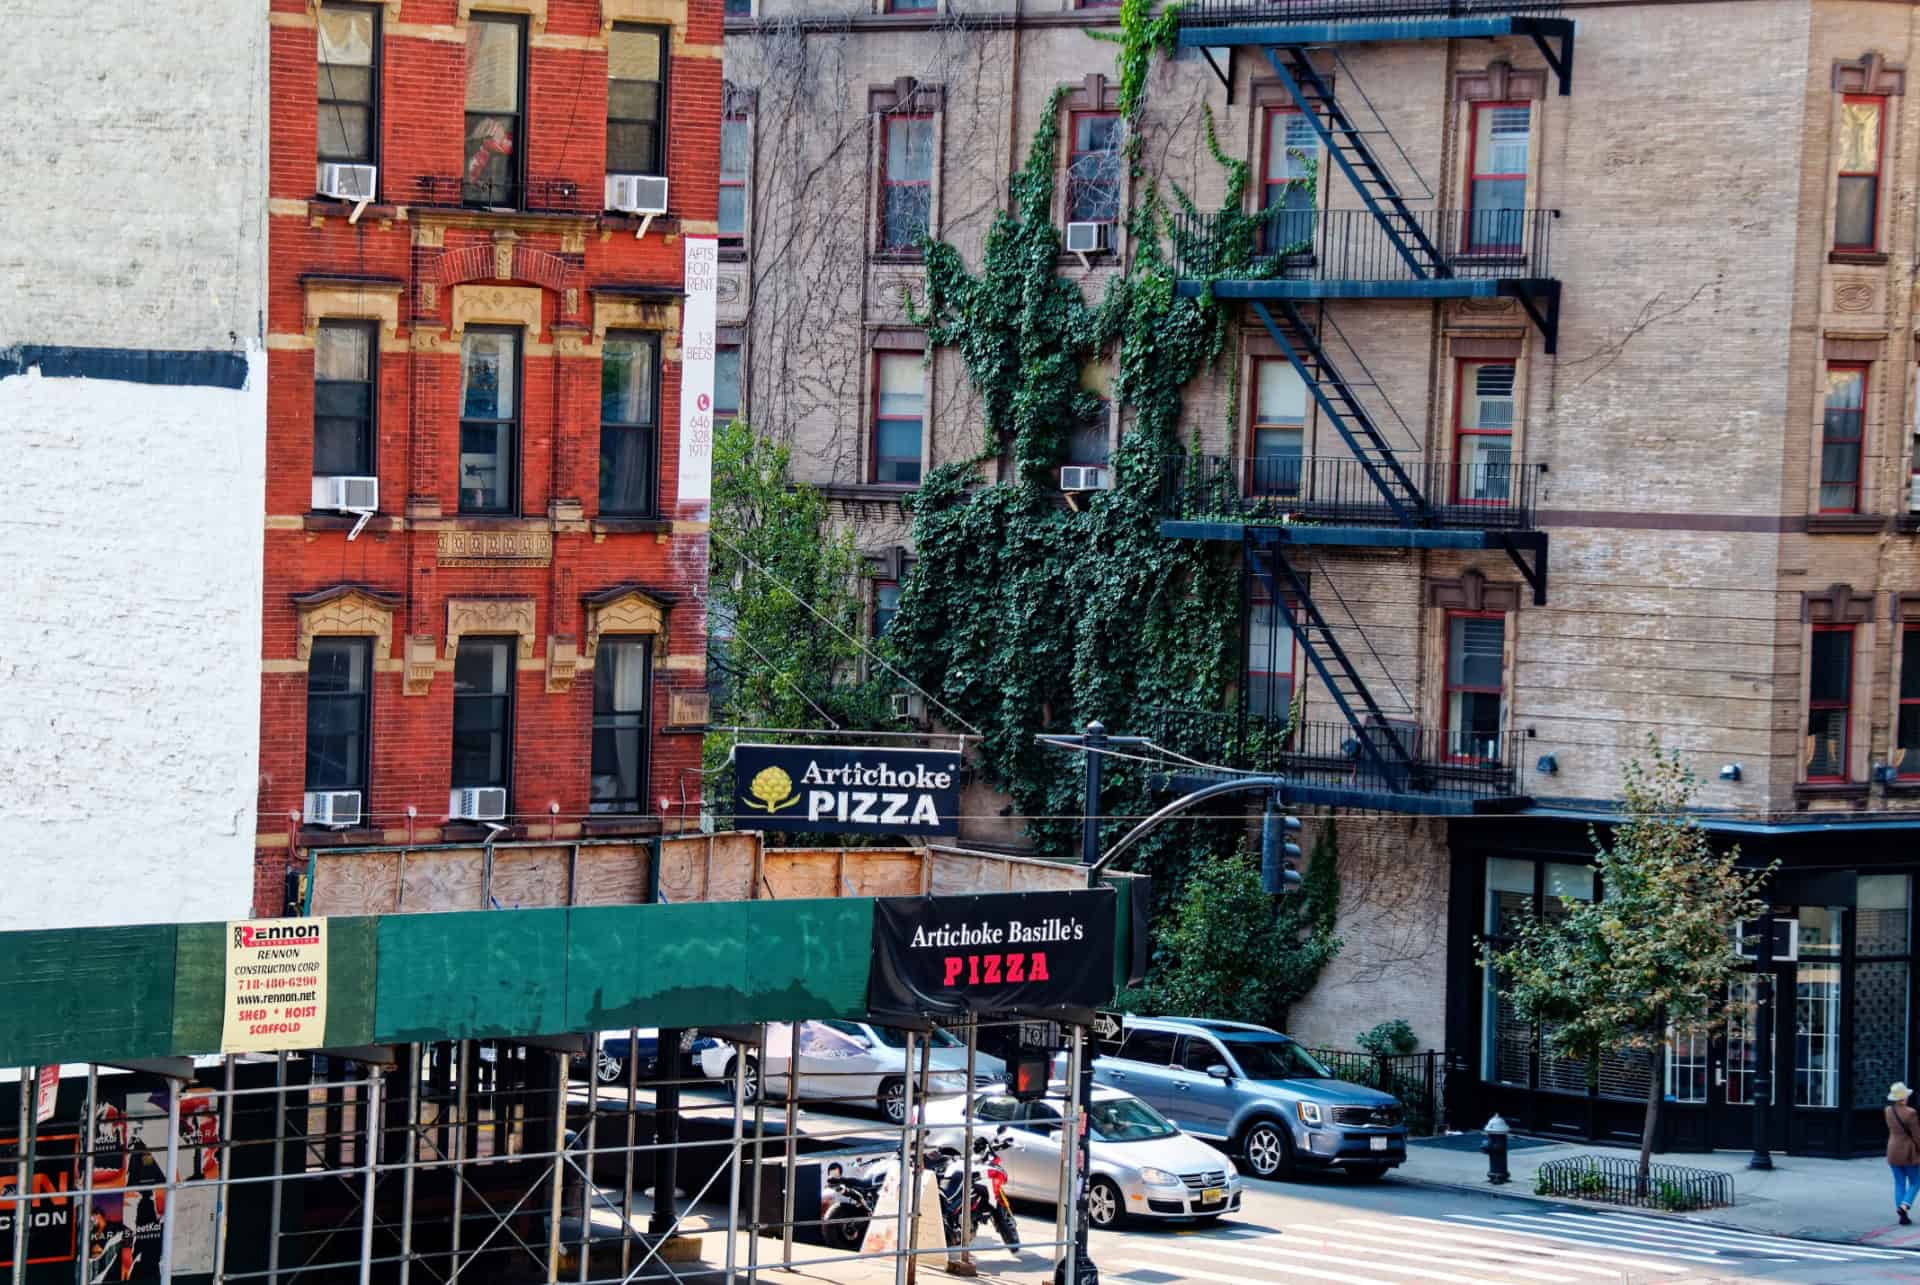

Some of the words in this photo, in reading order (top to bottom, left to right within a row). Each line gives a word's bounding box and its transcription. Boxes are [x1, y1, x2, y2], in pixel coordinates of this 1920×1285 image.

[688, 248, 714, 260] APTS
[688, 262, 710, 275] FOR
[687, 278, 714, 291] RENT
[686, 347, 713, 360] BEDS
[690, 416, 710, 428] 646
[691, 430, 709, 443] 328
[688, 445, 709, 457] 1917
[800, 760, 951, 789] Artichoke
[808, 790, 940, 826] PIZZA
[910, 921, 1003, 948] Artichoke
[1007, 917, 1083, 944] Basille's
[257, 949, 300, 960] RENNON
[234, 963, 297, 976] CONSTRUCTION
[943, 952, 1049, 986] PIZZA
[236, 990, 316, 1005] www.rennon.net
[239, 1009, 267, 1021] SHED
[285, 1006, 317, 1019] HOIST
[249, 1022, 301, 1035] SCAFFOLD
[0, 1211, 68, 1231] CION
